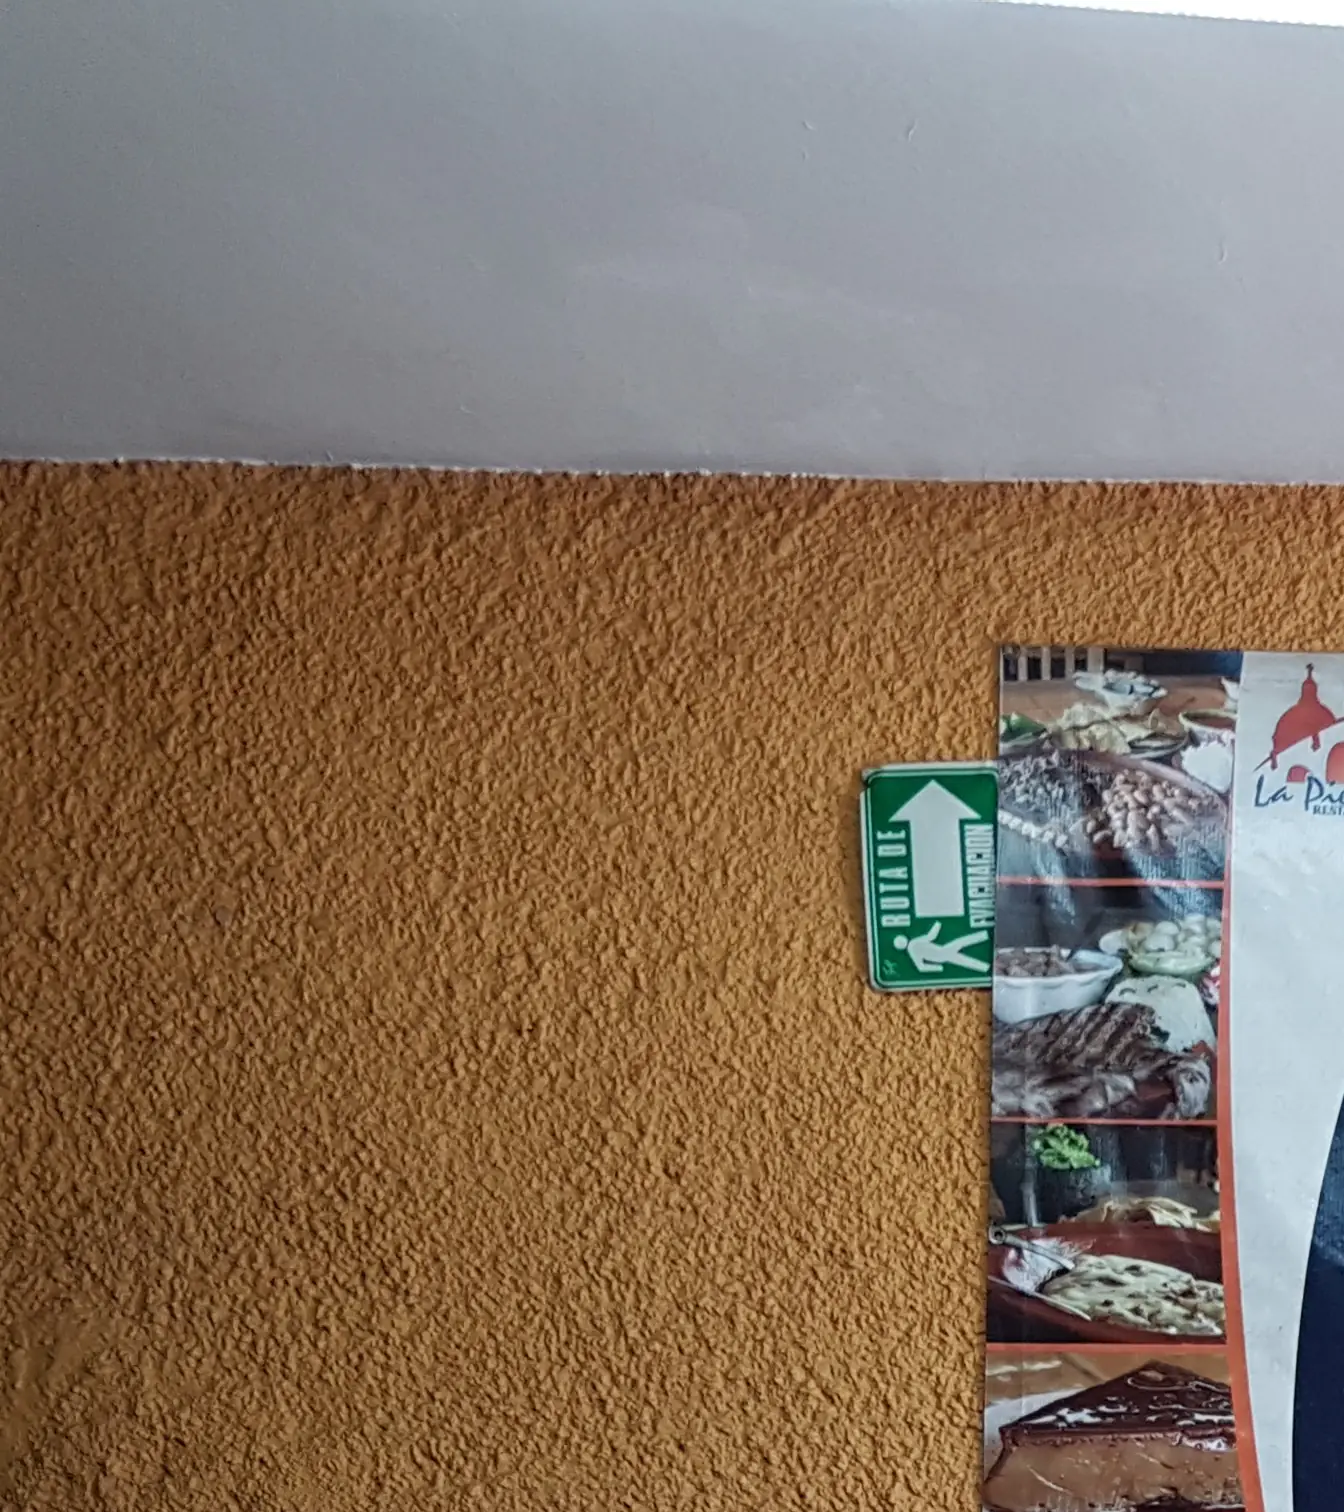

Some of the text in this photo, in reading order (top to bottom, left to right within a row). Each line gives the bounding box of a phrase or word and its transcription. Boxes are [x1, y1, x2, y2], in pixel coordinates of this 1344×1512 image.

[1254, 774, 1294, 807] La
[877, 830, 911, 927] RUTA DE
[964, 824, 995, 928] EVACUACION
